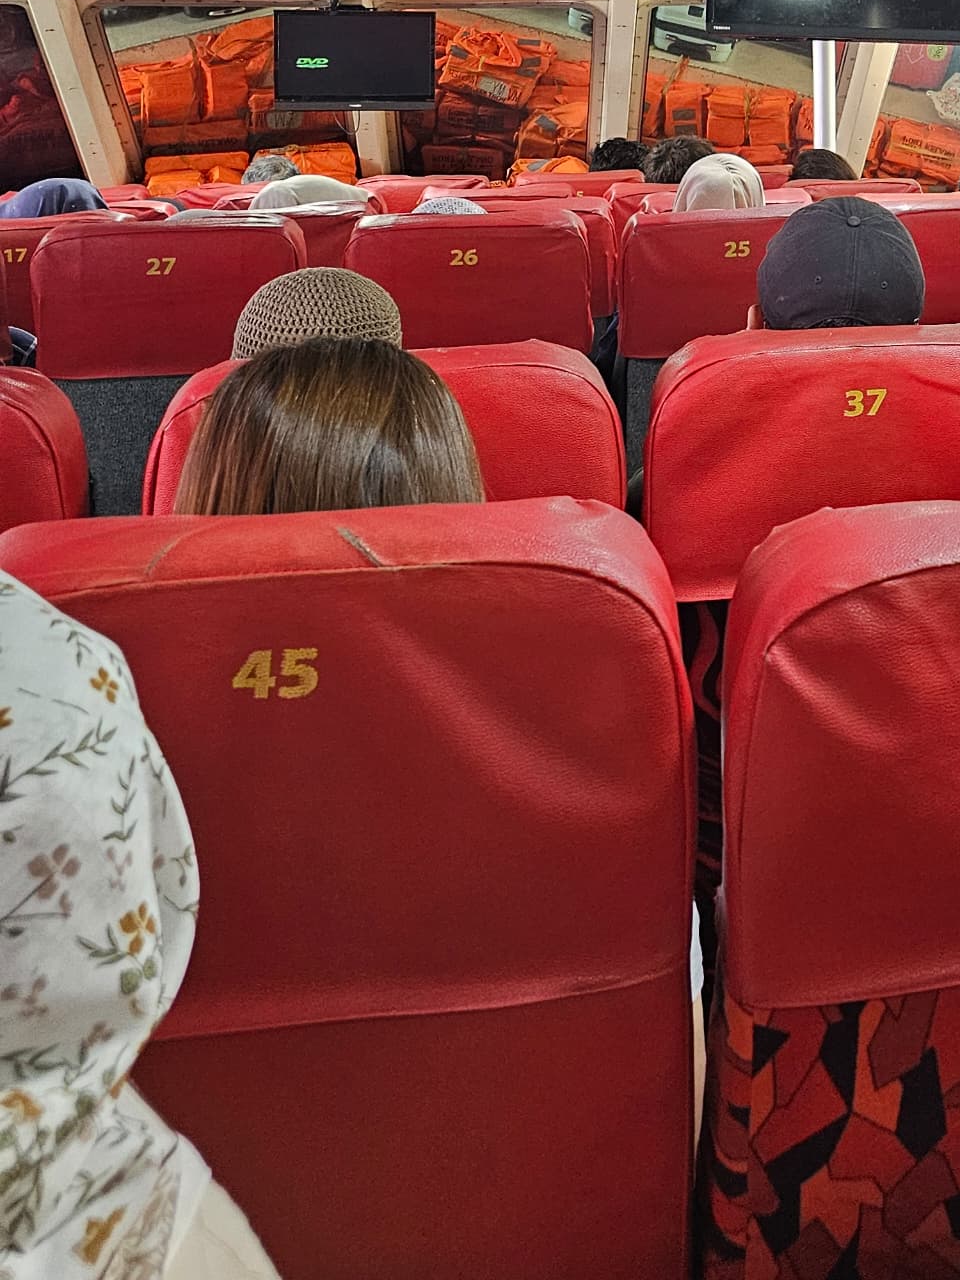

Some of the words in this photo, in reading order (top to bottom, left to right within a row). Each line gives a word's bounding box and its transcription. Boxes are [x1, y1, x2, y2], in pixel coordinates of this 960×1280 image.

[4, 248, 27, 263] 17
[449, 249, 479, 267] 26
[724, 240, 751, 259] 25
[146, 257, 177, 276] 27
[843, 388, 887, 417] 37
[230, 647, 319, 699] 45
